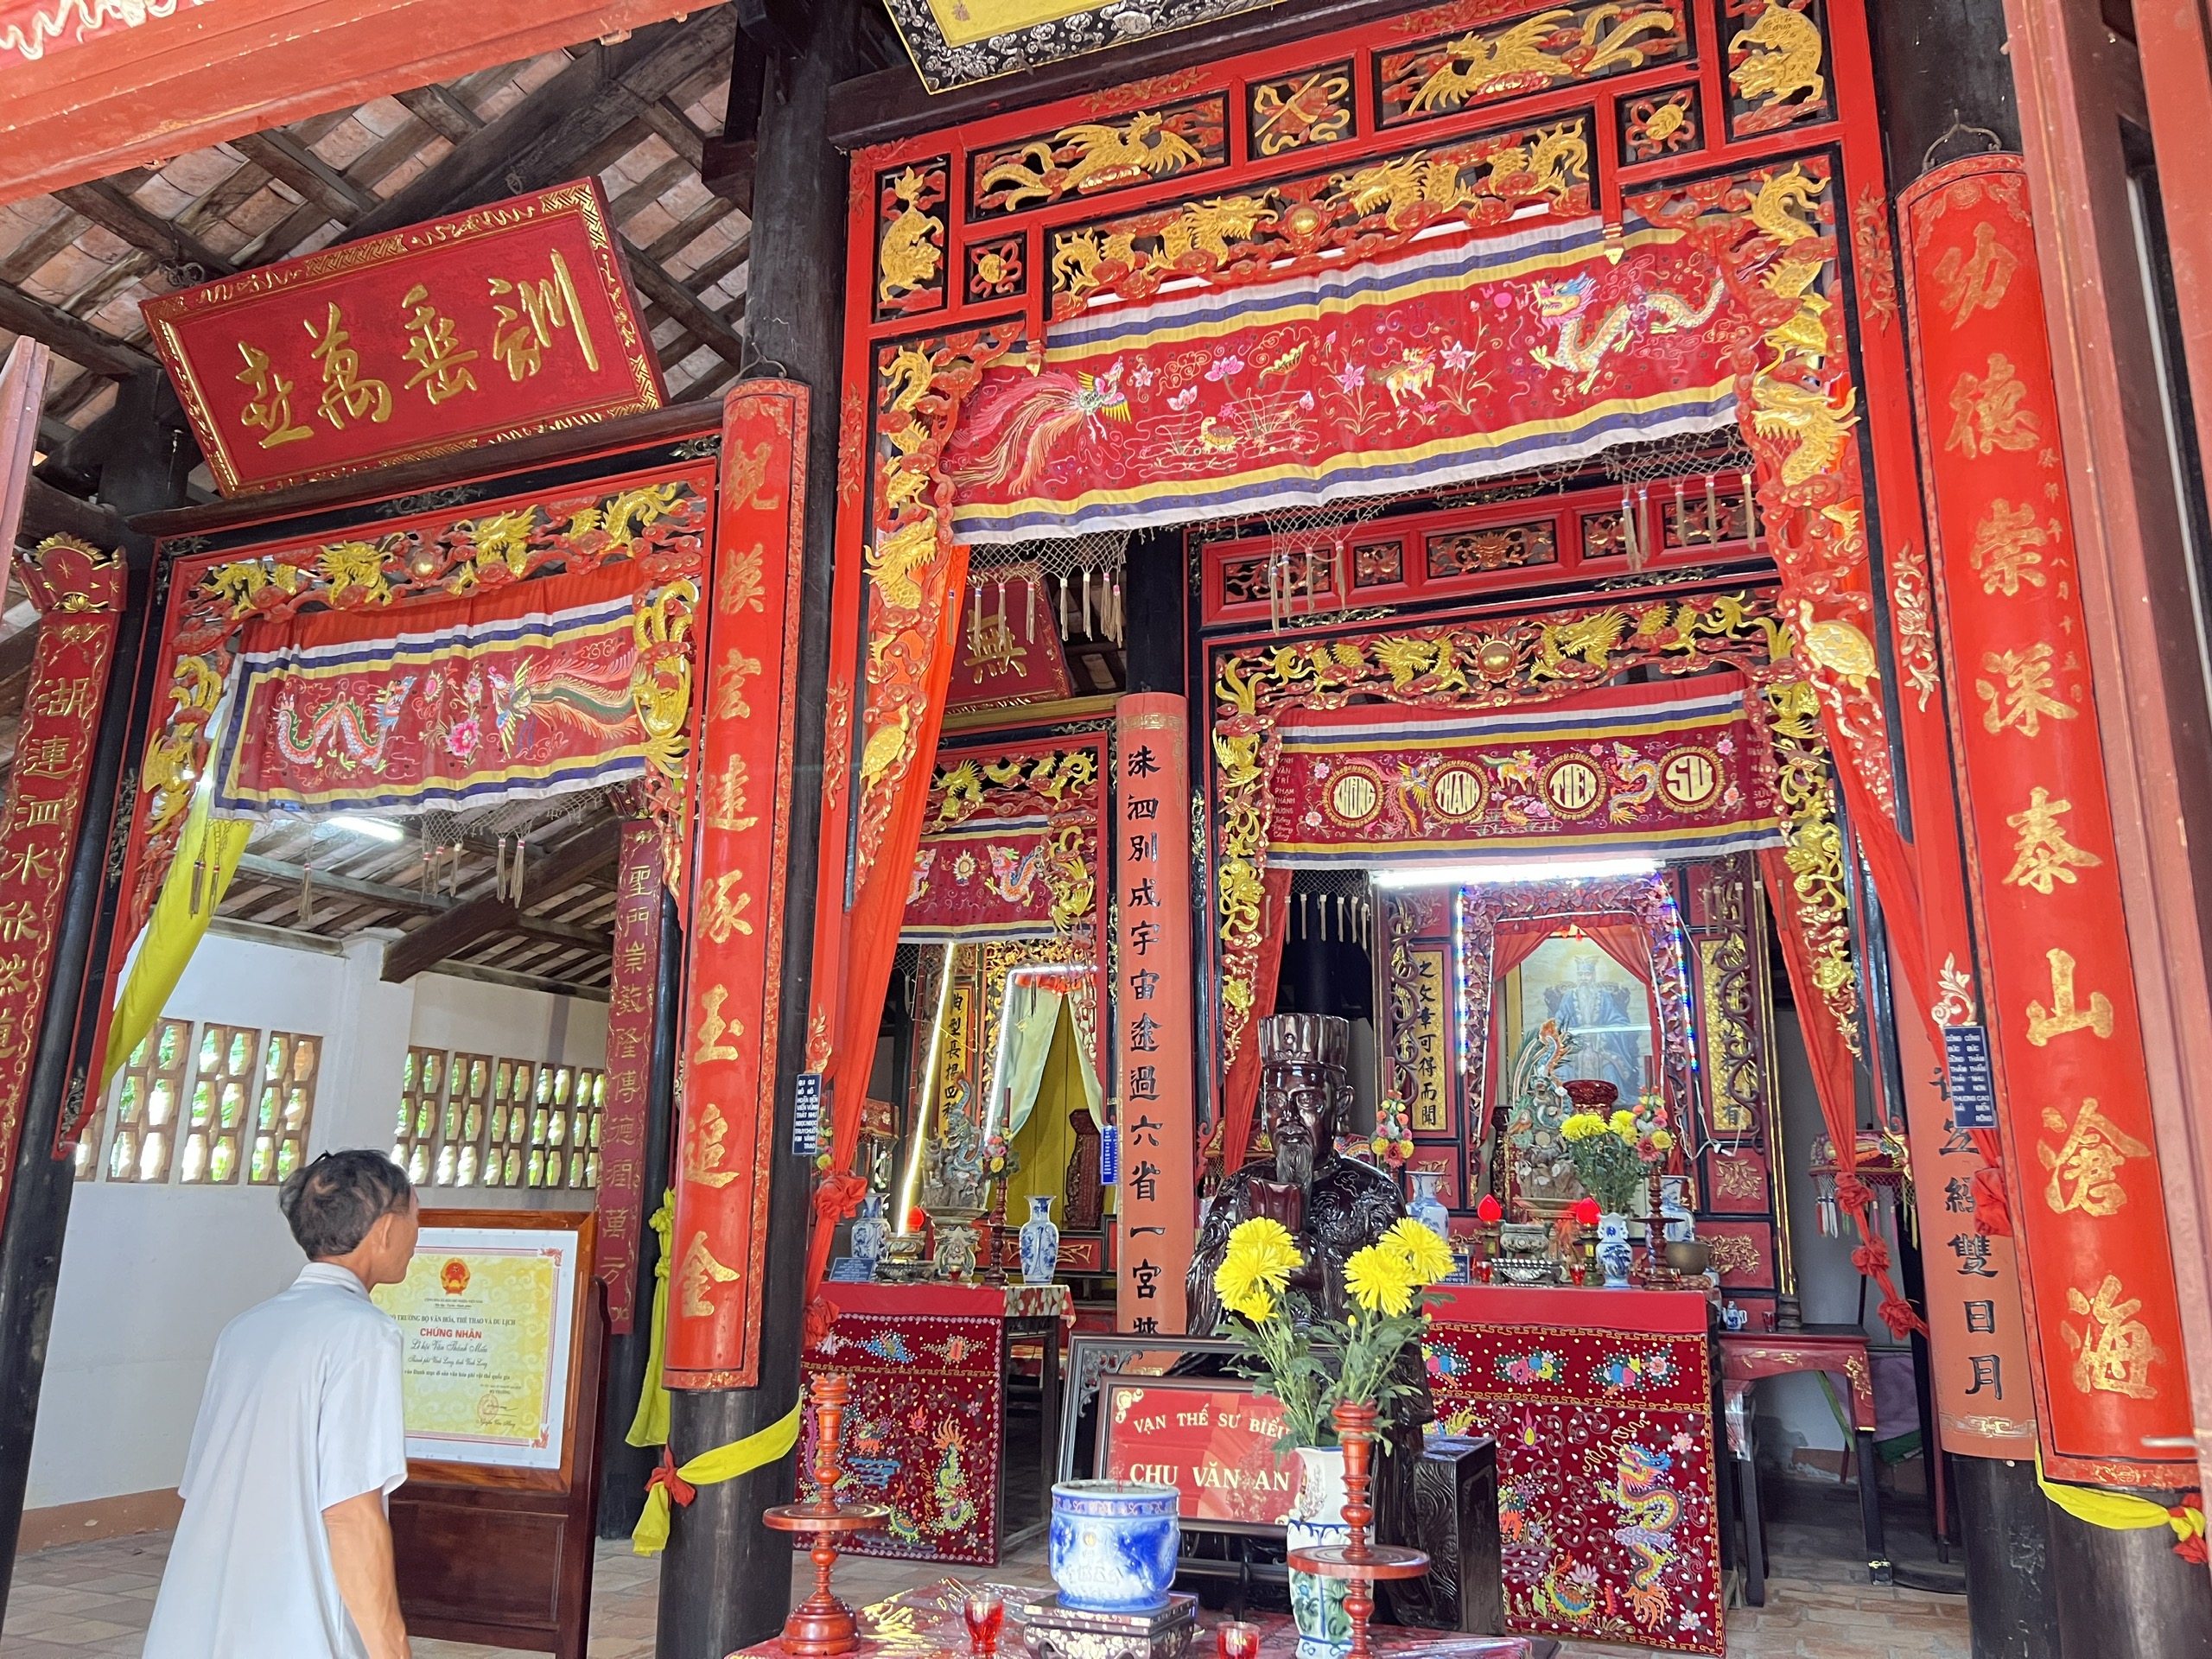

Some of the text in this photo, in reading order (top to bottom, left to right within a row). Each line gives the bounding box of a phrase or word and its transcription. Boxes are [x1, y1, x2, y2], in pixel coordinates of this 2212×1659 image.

[420, 1326, 482, 1341] CHỨNG NHẬN
[1134, 1414, 1166, 1434] VẠN
[1177, 1403, 1210, 1427] THẾ
[1217, 1413, 1242, 1428] SƯ
[1130, 1462, 1289, 1491] CHU VĂN AN
